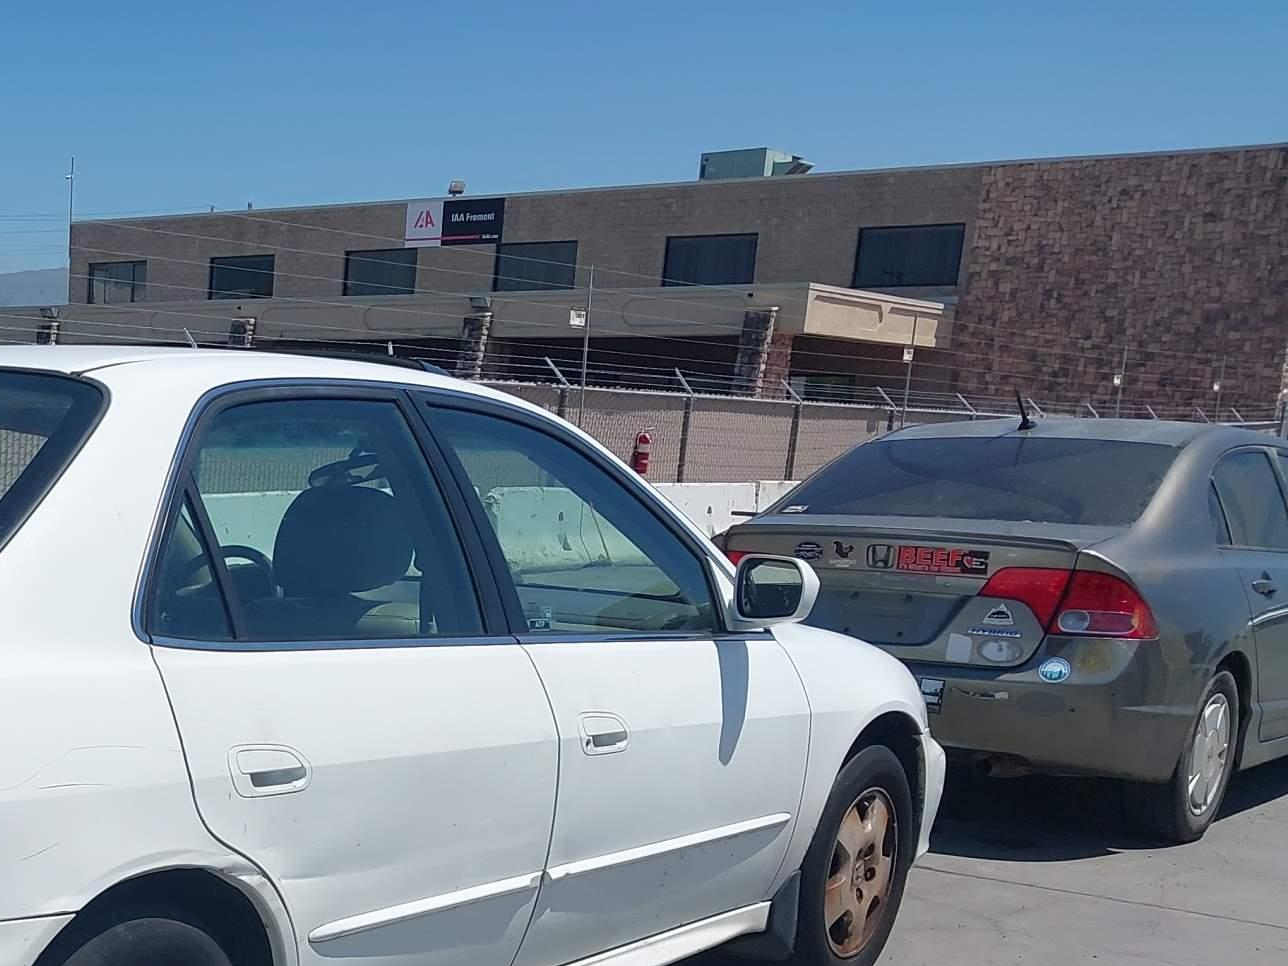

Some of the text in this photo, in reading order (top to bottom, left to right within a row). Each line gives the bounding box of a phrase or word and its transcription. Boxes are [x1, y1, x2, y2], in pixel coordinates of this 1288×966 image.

[451, 212, 495, 222] IAA Fremont
[899, 546, 964, 567] BEEF
